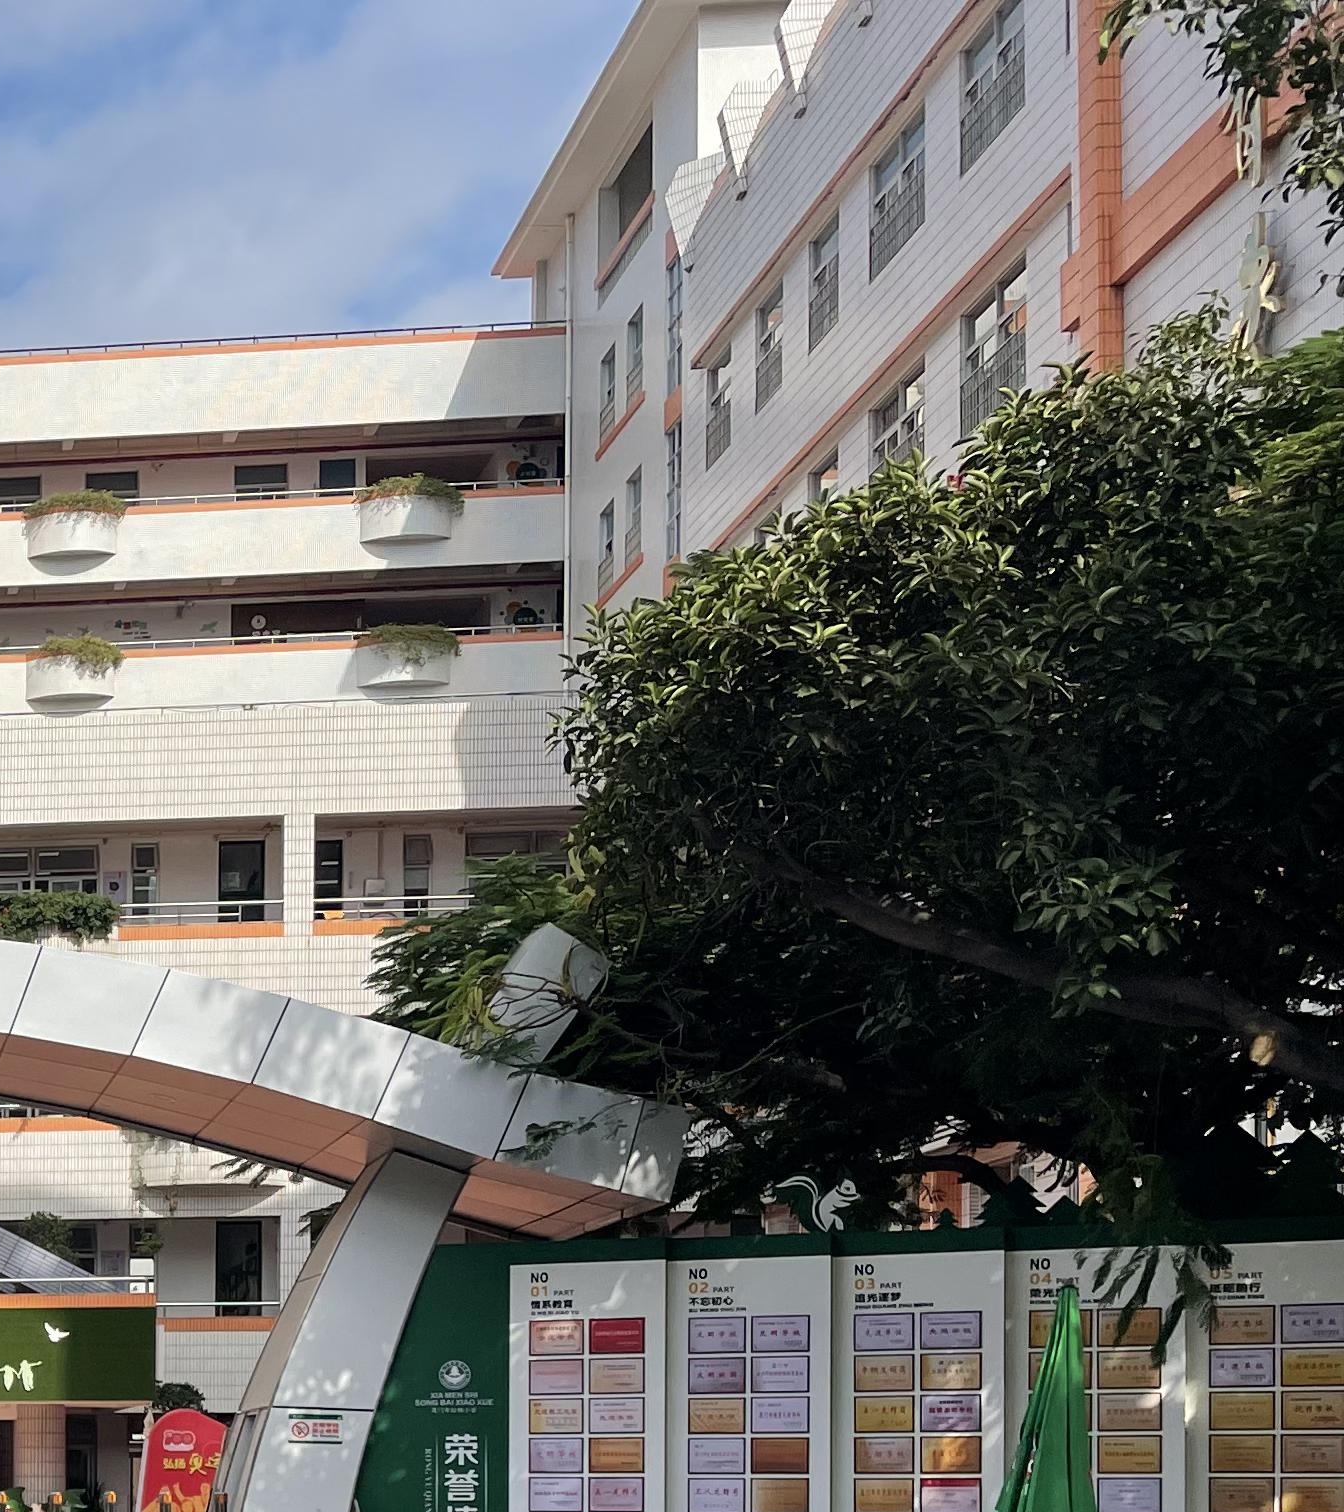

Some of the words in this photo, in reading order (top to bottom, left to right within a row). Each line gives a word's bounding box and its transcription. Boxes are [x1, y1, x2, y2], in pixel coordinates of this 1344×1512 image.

[854, 1263, 875, 1276] NO
[1029, 1257, 1051, 1271] NO
[530, 1271, 549, 1284] NO
[688, 1268, 708, 1280] NO
[1029, 1272, 1052, 1285] 04
[530, 1285, 549, 1297] 01
[688, 1282, 710, 1294] 02
[854, 1278, 876, 1291] 03
[688, 1296, 734, 1306] 不忘初心
